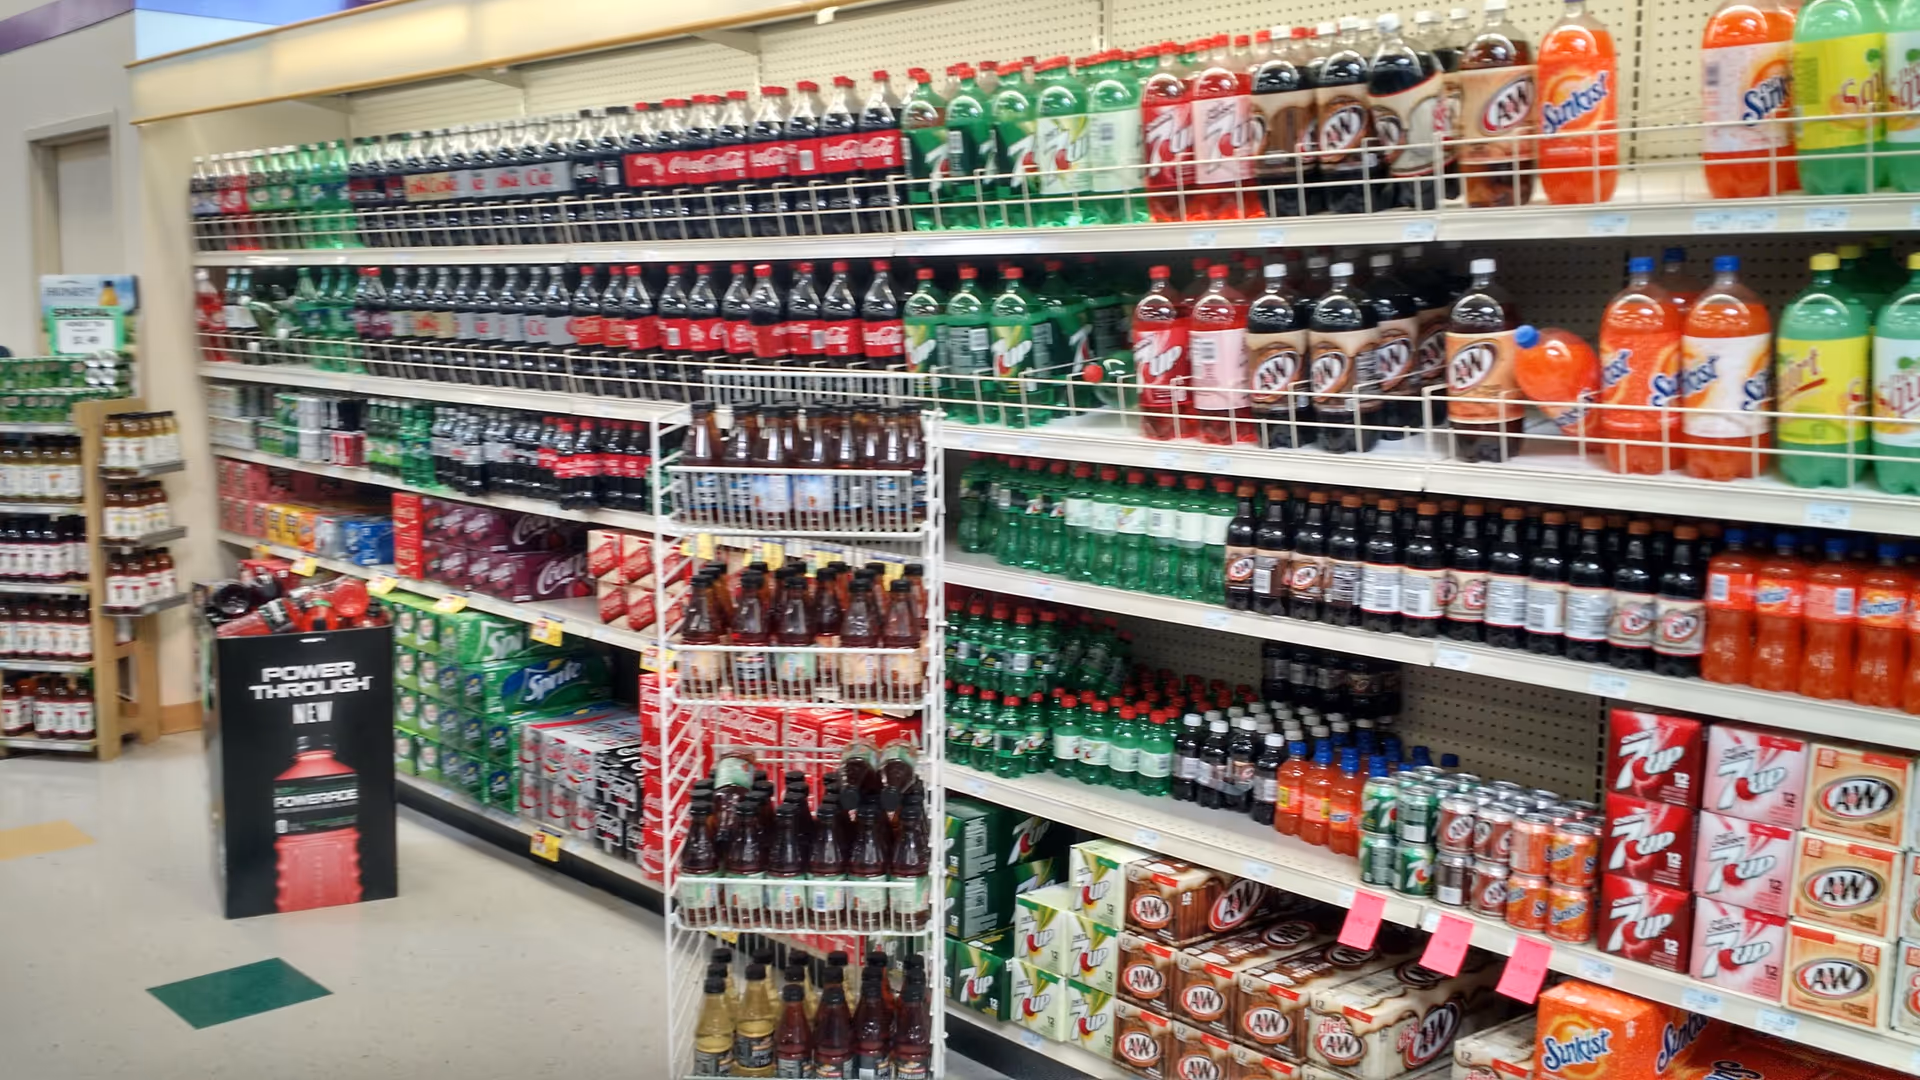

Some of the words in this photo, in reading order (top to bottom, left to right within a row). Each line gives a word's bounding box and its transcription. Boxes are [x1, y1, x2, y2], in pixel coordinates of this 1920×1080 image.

[1543, 69, 1610, 135] Sunkist
[249, 677, 371, 699] THROUGH
[262, 662, 356, 682] POWER
[524, 660, 582, 702] Sprite
[292, 701, 333, 724] NEW
[1616, 737, 1685, 791] 7UP
[273, 788, 359, 809] POWERADE
[1717, 757, 1786, 810] 7UP
[1608, 819, 1676, 871] 7UP
[1665, 852, 1682, 869] 12
[1705, 845, 1776, 894] 7UP
[1072, 874, 1110, 912] 7UP
[1820, 873, 1869, 901] A&W
[1139, 898, 1166, 920] A&W
[1017, 921, 1055, 958] 7UP
[1606, 899, 1674, 953] 7UP
[1069, 939, 1109, 978] 7UP
[1663, 938, 1679, 956] 12
[1701, 929, 1772, 979] 7UP
[959, 967, 994, 1003] 7UP
[1131, 970, 1158, 989] A&W
[1809, 967, 1857, 991] A&W
[988, 998, 999, 1011] 12
[1012, 985, 1051, 1022] 7UP
[1190, 991, 1218, 1010] A&W
[1067, 1004, 1108, 1041] 7UP
[1252, 1012, 1282, 1033] A&W
[1127, 1038, 1153, 1057] A&W
[1324, 1034, 1356, 1054] A&W
[1543, 1029, 1612, 1071] Sunkist
